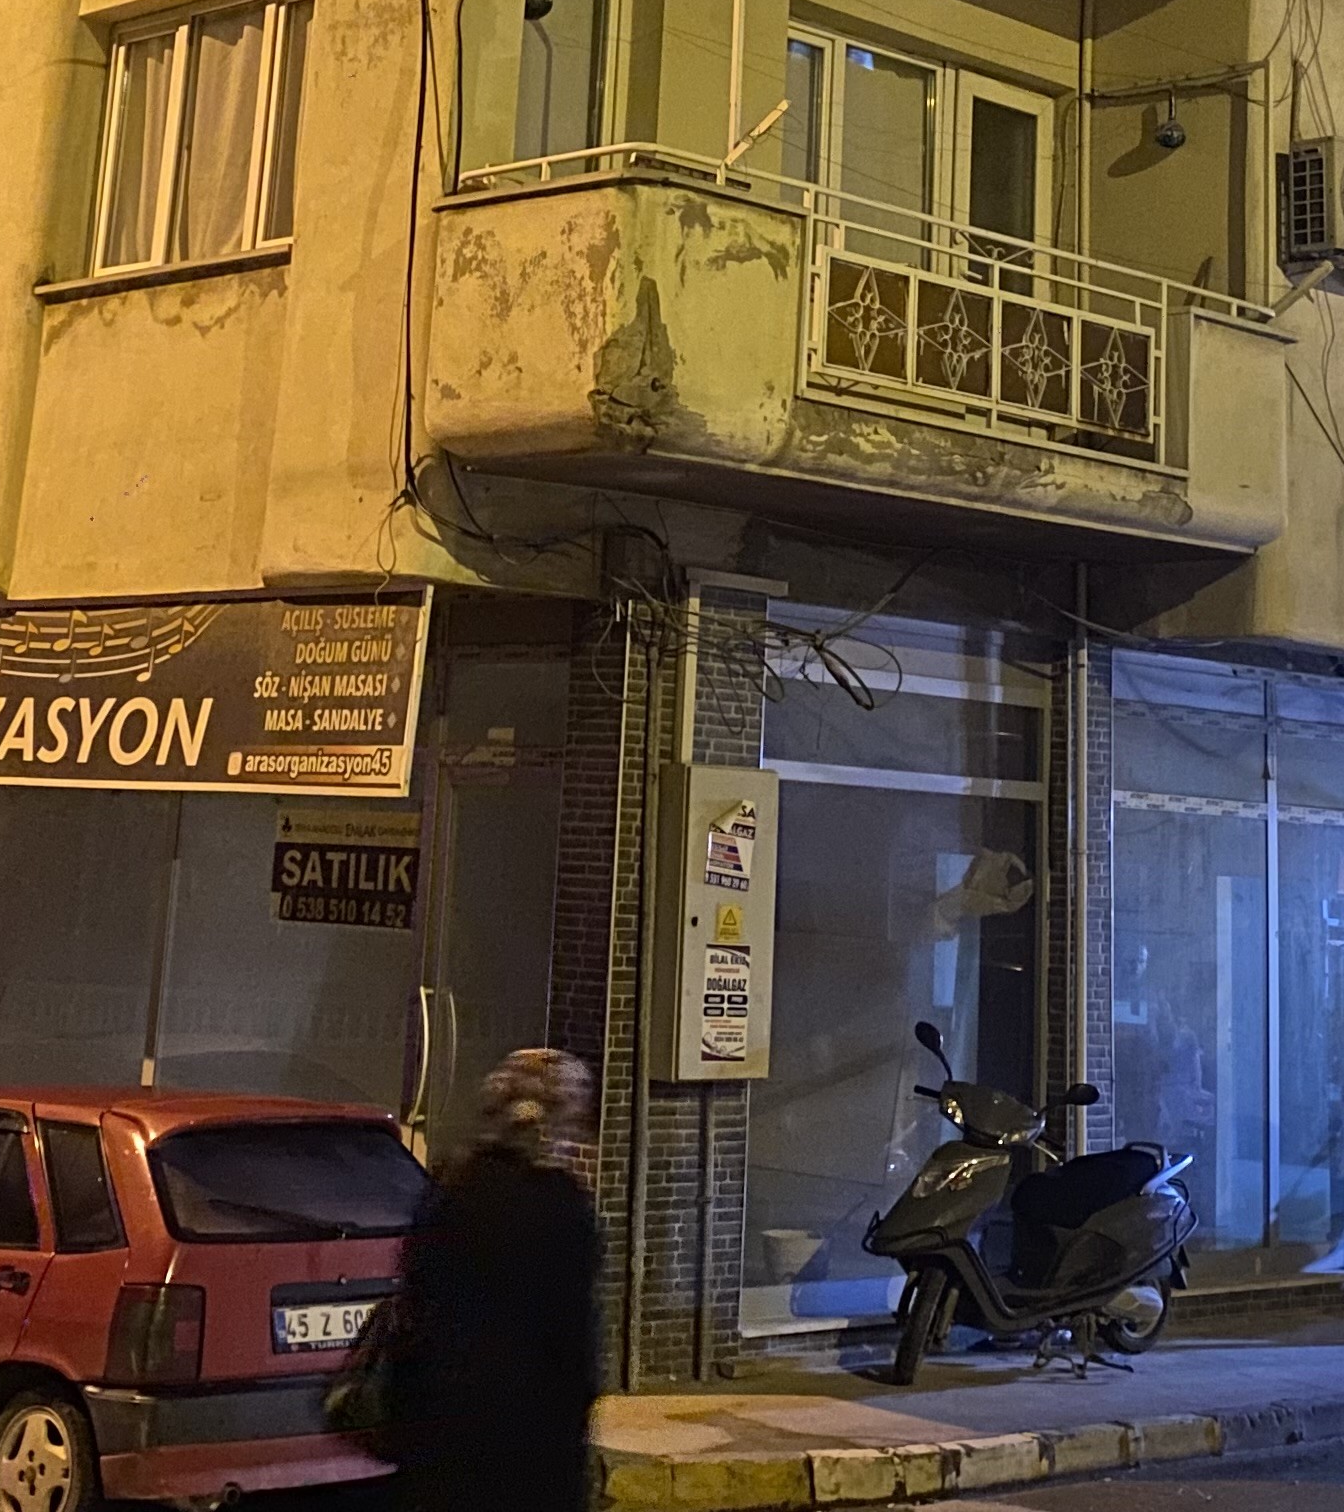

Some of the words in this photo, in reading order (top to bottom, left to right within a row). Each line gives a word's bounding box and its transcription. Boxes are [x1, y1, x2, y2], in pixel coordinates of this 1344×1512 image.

[281, 609, 324, 637] AÇILIŞ
[295, 638, 347, 664] DOĞUM
[351, 635, 392, 662] GÜNÜ
[253, 671, 280, 697] SÖZ
[289, 670, 331, 703] NİŞAN
[333, 674, 388, 696] MASASI
[264, 709, 303, 731] MASA
[312, 709, 384, 731] SANDALYE
[245, 749, 391, 779] arasorganizasyon45
[281, 849, 413, 893] SATILIK
[283, 895, 292, 918] 0
[296, 896, 324, 920] 538
[329, 899, 356, 922] 510
[362, 901, 381, 924] 14
[385, 903, 406, 926] 52
[707, 975, 747, 992] DOĞALGAZ
[287, 1313, 309, 1338] 45
[320, 1312, 332, 1336] Z
[343, 1309, 364, 1334] 60
